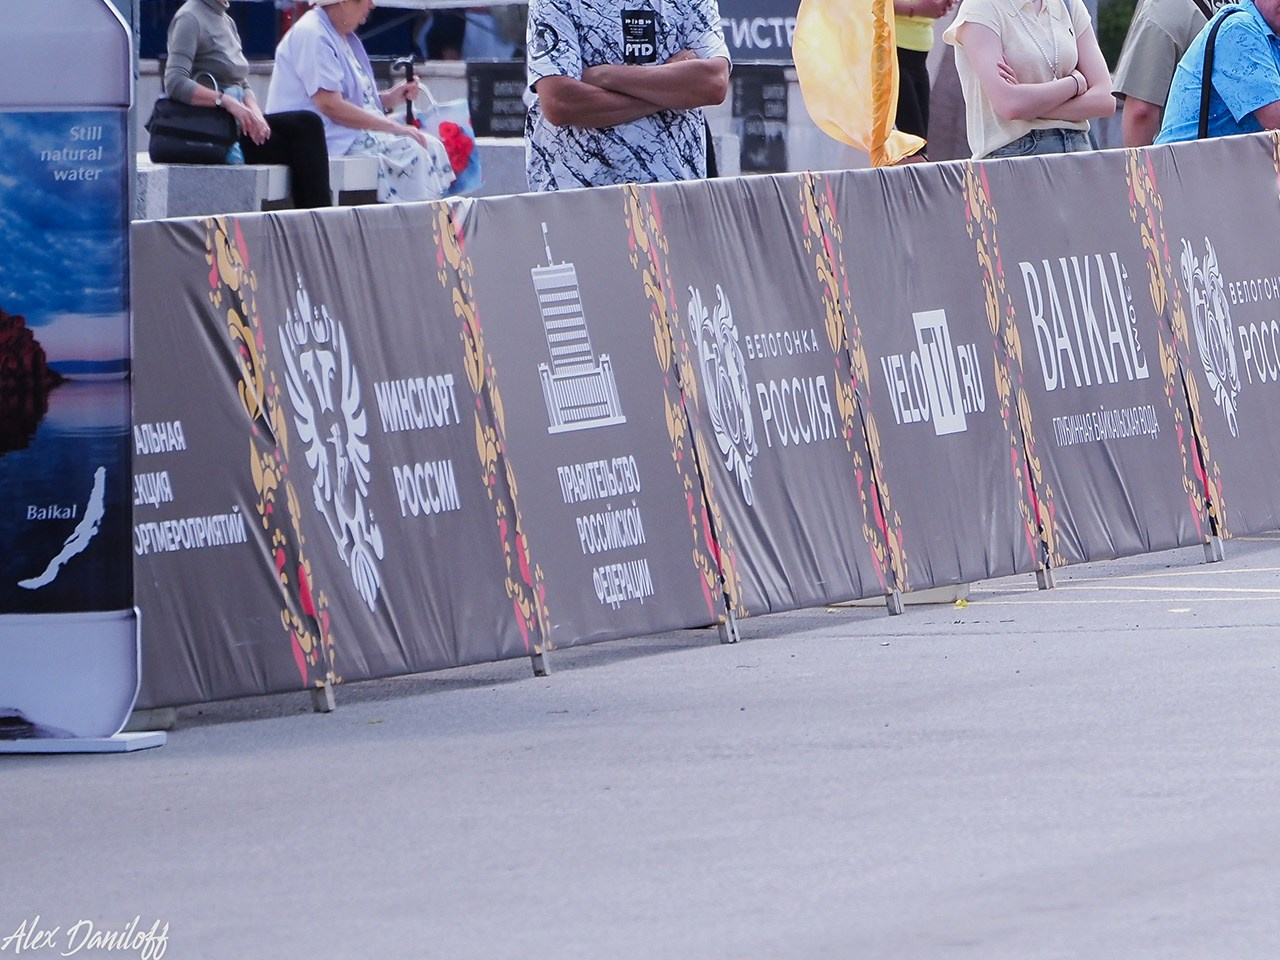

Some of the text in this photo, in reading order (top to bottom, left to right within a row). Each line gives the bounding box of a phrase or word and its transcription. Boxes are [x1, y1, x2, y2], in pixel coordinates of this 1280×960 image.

[40, 146, 102, 161] natural
[70, 126, 101, 141] Still
[54, 167, 103, 181] water
[744, 328, 818, 360] ВЕЛОГОНКА
[1018, 252, 1149, 391] BAIKAL
[374, 373, 461, 434] МИНСПОРТ
[757, 375, 837, 448] РОССИЯ
[134, 420, 187, 455] АЛЬНАЯ
[393, 459, 461, 518] РОССИИ
[557, 455, 641, 504] ПРАВИТЕЛЬСТВО
[26, 504, 76, 521] Baikal
[576, 503, 646, 555] РОССИЙСКОЙ
[593, 558, 655, 611] ФЕДЕРАЦИИ
